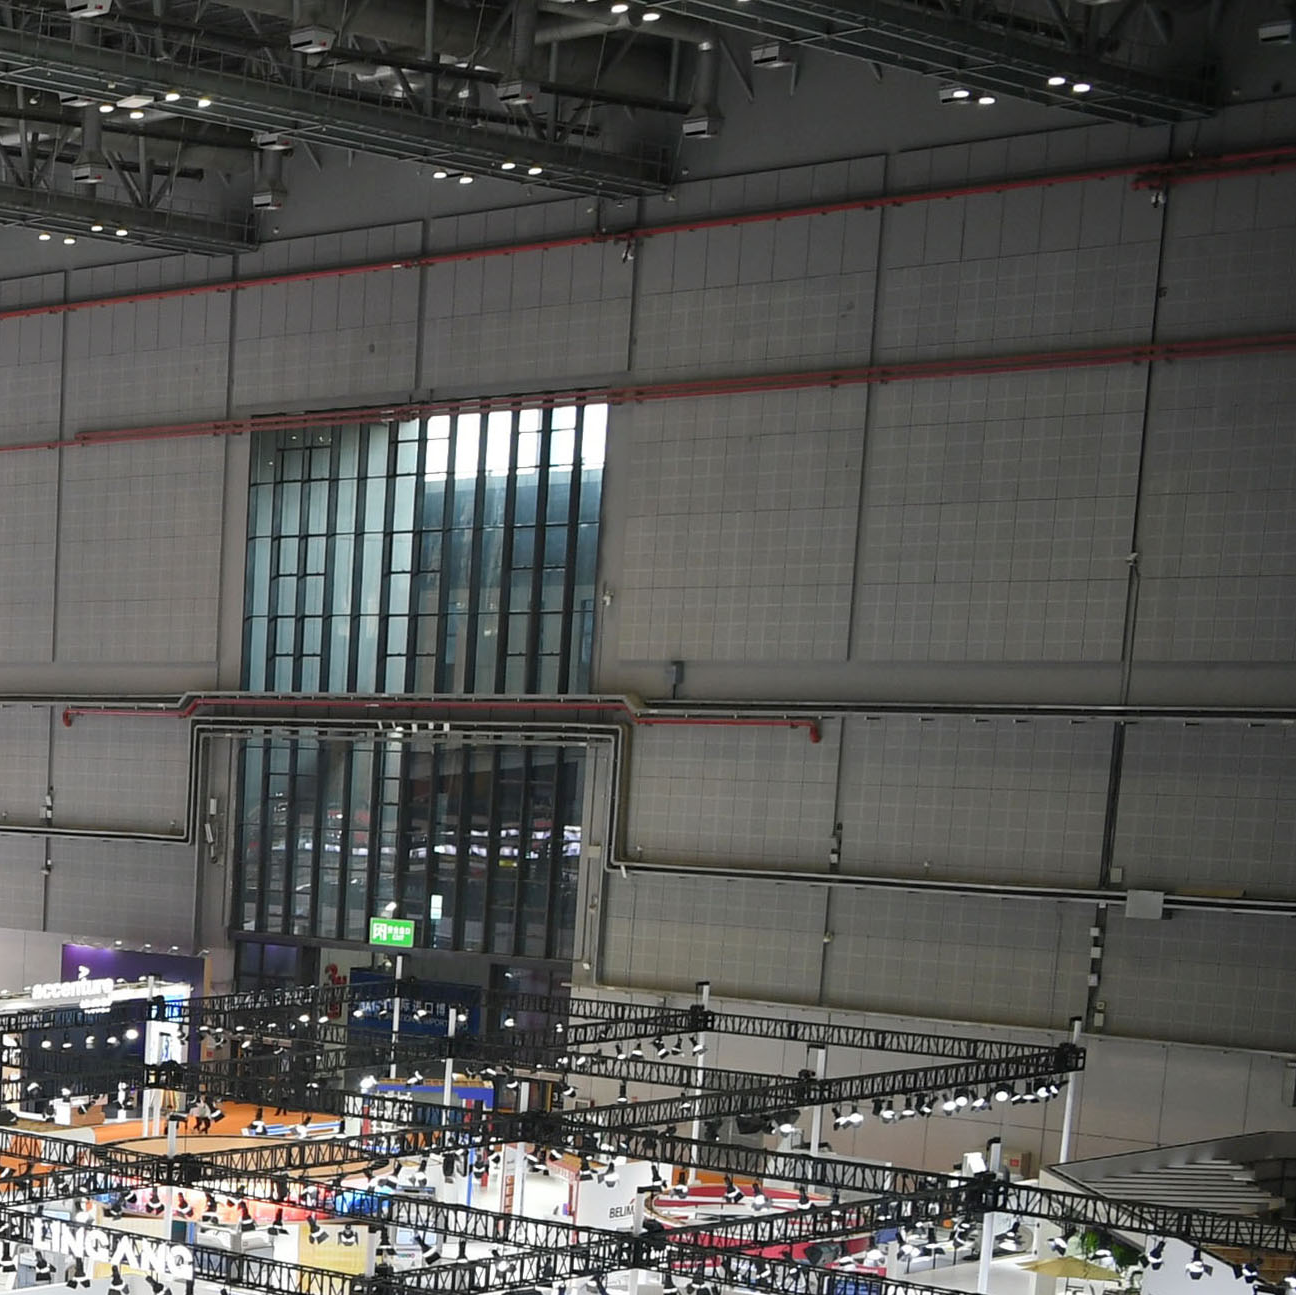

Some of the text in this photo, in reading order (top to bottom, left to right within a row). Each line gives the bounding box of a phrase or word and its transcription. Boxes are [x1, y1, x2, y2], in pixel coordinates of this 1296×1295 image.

[32, 977, 114, 999] accenture
[609, 1205, 635, 1219] BELIM
[33, 1217, 194, 1280] LINGANG
